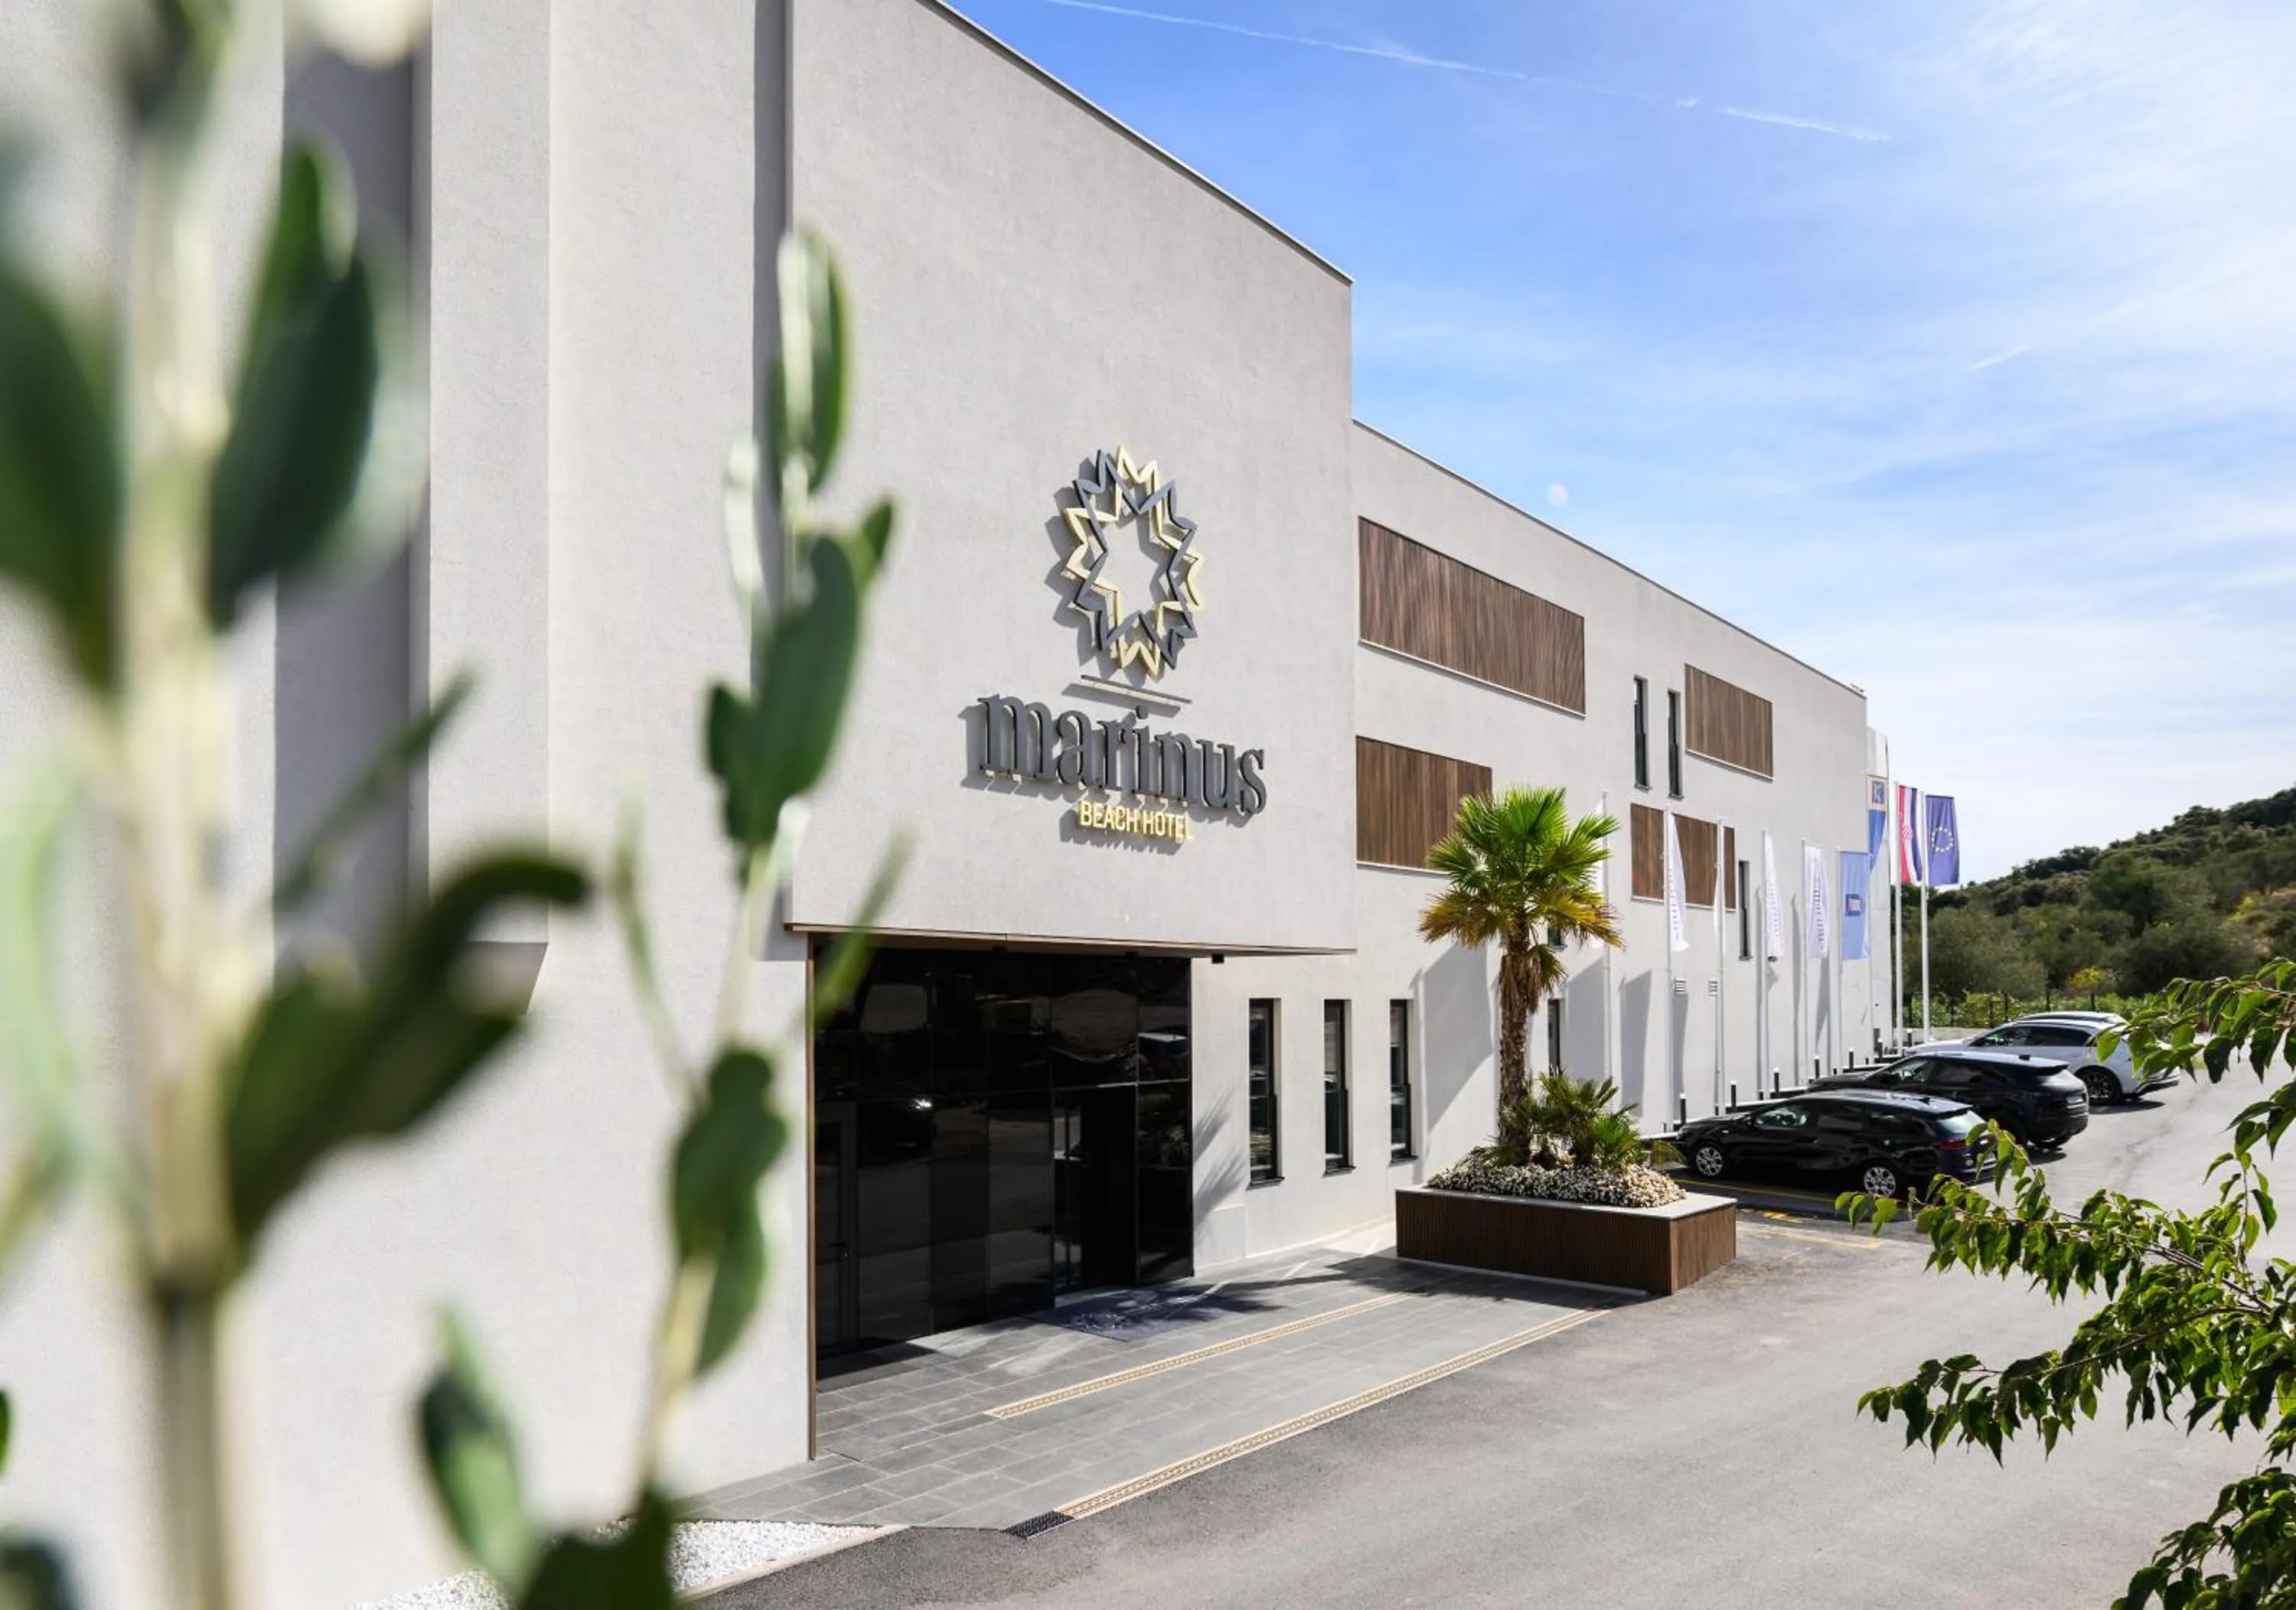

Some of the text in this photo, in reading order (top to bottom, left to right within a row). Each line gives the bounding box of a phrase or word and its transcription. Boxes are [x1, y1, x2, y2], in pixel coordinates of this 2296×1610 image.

[977, 694, 1267, 815] marinus
[1078, 800, 1195, 843] BEACH HOTEL
